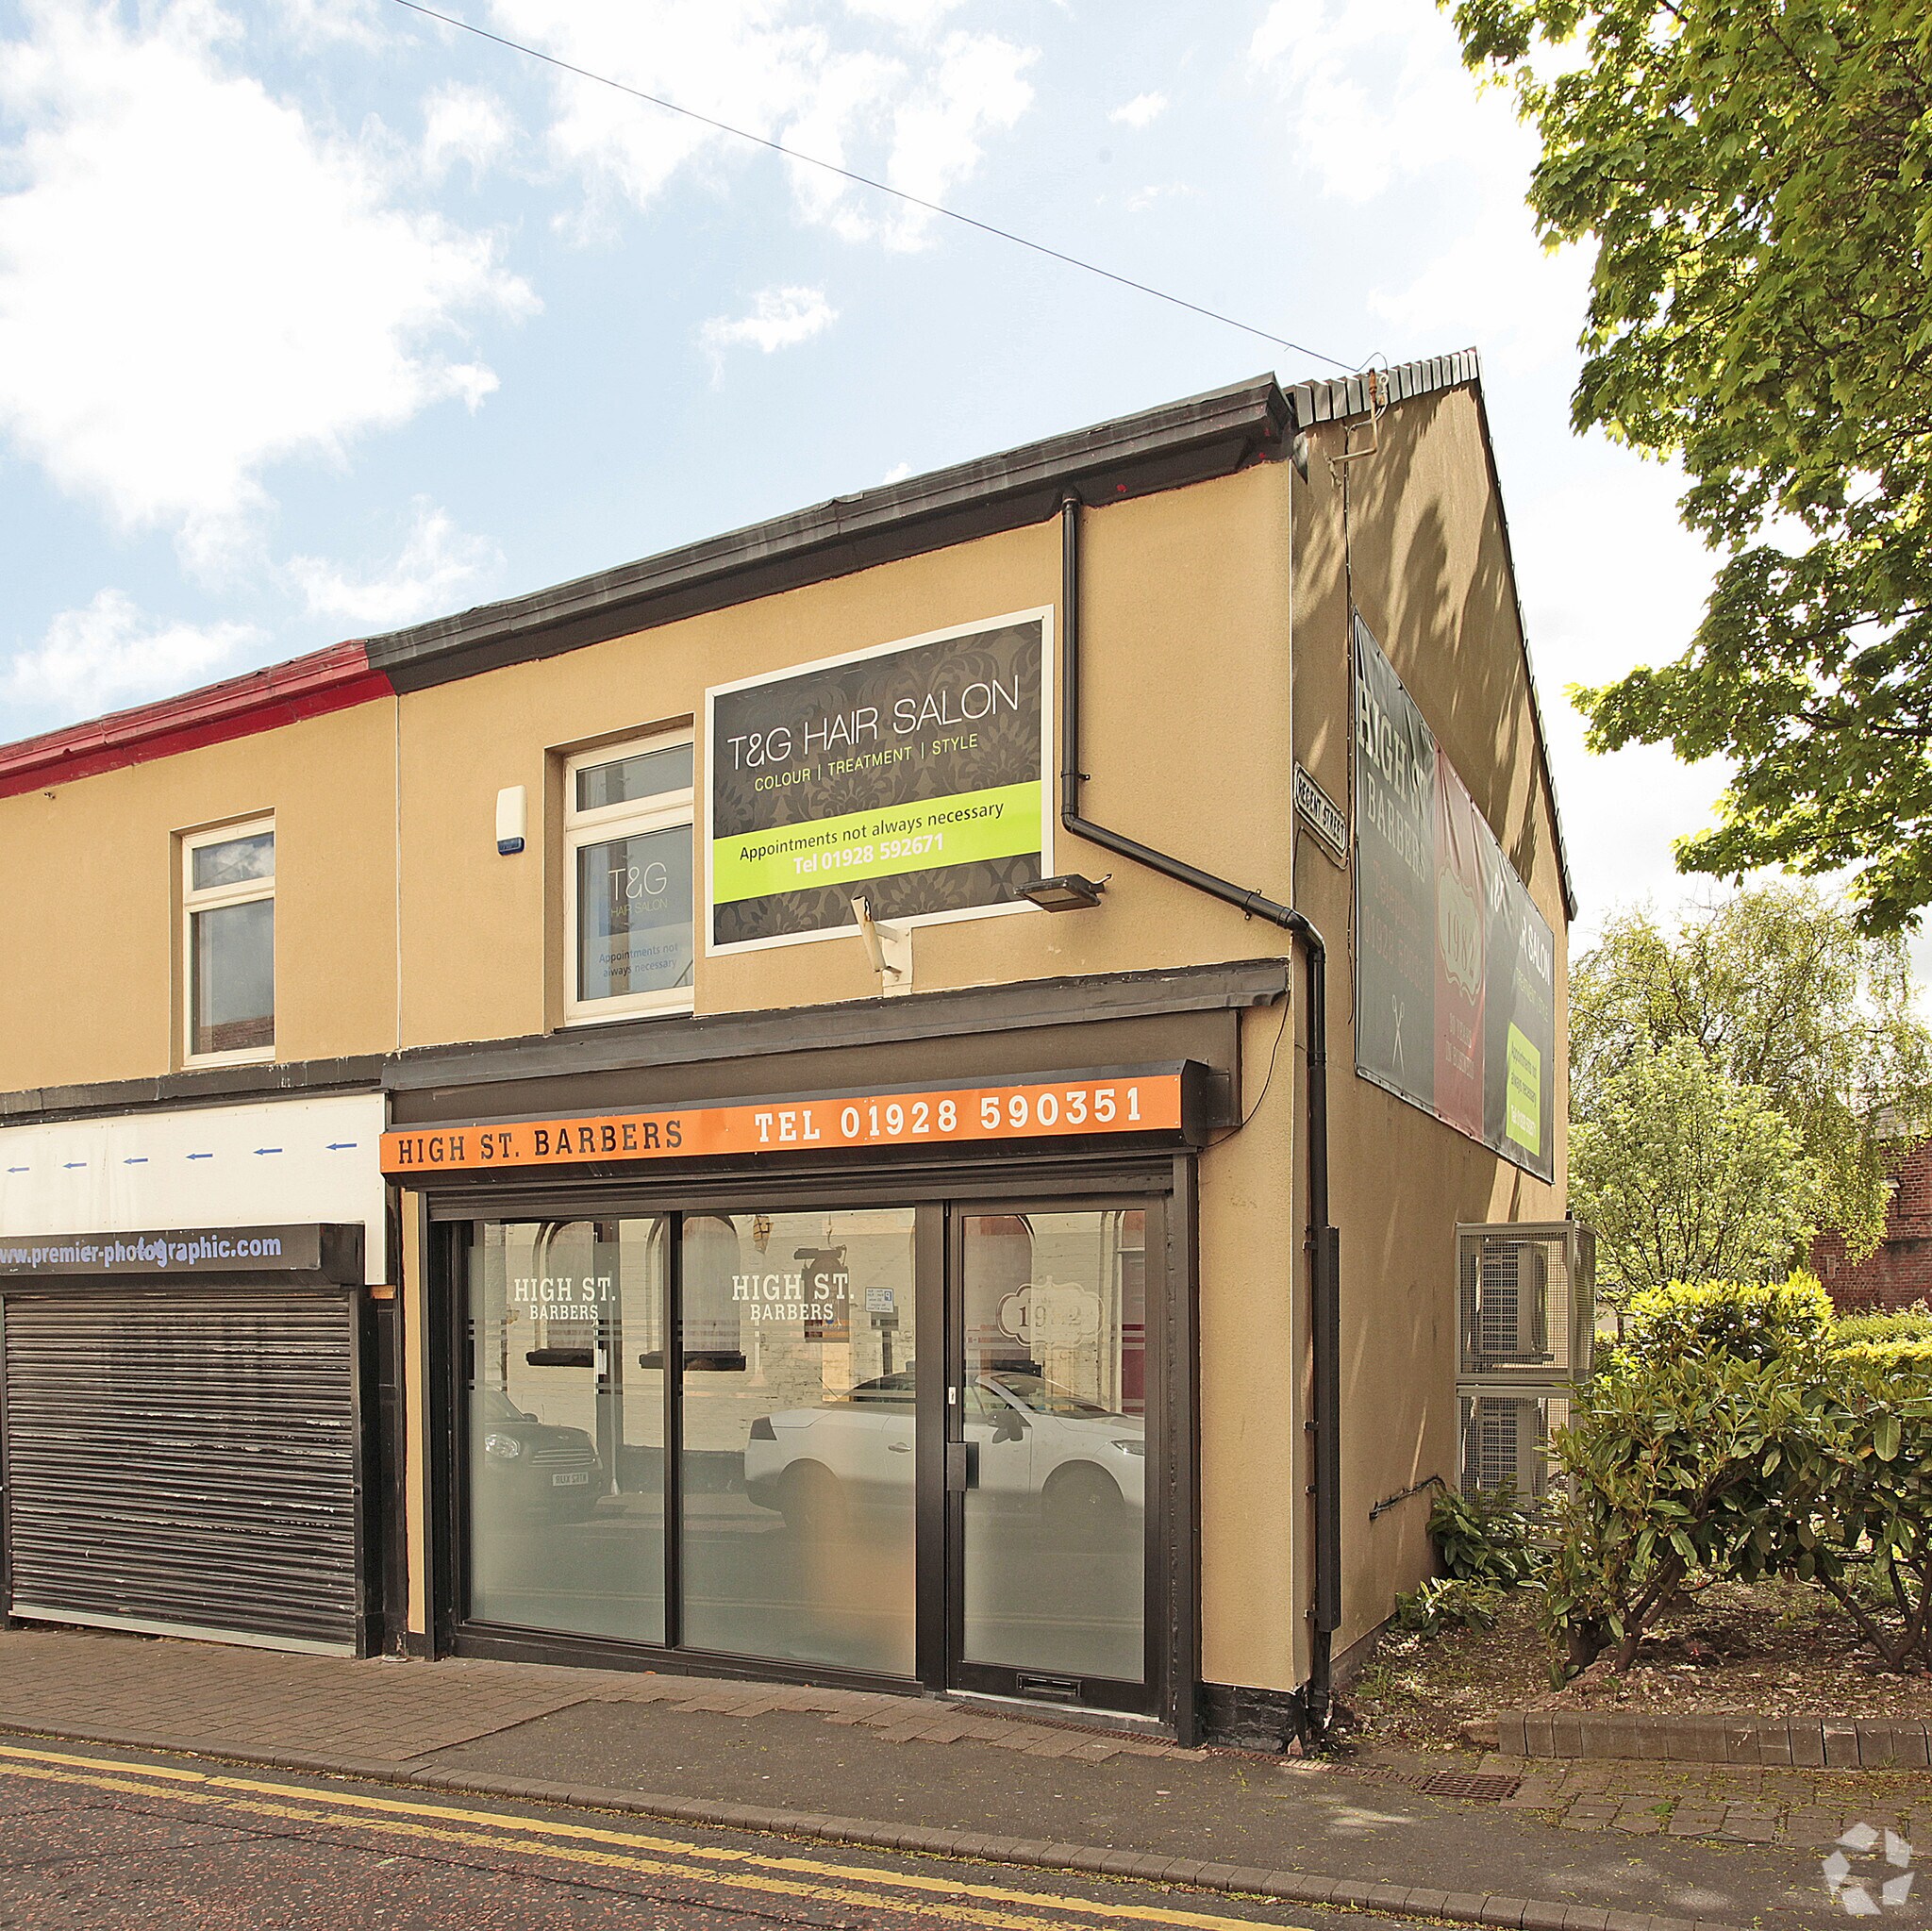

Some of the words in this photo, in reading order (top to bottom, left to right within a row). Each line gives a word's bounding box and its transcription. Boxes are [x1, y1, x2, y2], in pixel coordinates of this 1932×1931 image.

[727, 727, 791, 771] T&G
[804, 707, 878, 755] HAIR
[892, 674, 1019, 734] SALON
[1357, 676, 1407, 803] HIGH
[755, 768, 811, 792] COLOUR
[828, 746, 912, 776] TREATMENT
[932, 733, 978, 756] STYLE
[739, 831, 838, 862] Appointments
[842, 824, 867, 841] not
[872, 815, 923, 839] always
[927, 801, 1005, 827] necessary
[1298, 777, 1322, 819] REGENT
[1323, 804, 1345, 844] STREET
[1367, 772, 1425, 884] BARBERS
[793, 854, 818, 874] Tel
[821, 844, 874, 871] 01928
[878, 832, 943, 861] 592671
[608, 861, 667, 901] T&G
[610, 903, 631, 918] HAIR
[635, 897, 668, 914] SALON
[599, 944, 660, 965] Appointments
[662, 943, 678, 955] not
[1362, 905, 1394, 964] 01928
[1447, 909, 1474, 978] 1982
[1528, 923, 1551, 987] SALON
[603, 964, 631, 978] always
[634, 957, 676, 974] necessary
[755, 1109, 820, 1142] TEL
[841, 1099, 958, 1138] 01928
[980, 1087, 1141, 1129] 590351
[398, 1135, 465, 1164] HIGH
[480, 1132, 520, 1160] ST.
[534, 1119, 683, 1157] BARBERS
[514, 1277, 573, 1303] HIGH
[582, 1276, 616, 1302] ST.
[732, 1273, 802, 1301] HIGH
[814, 1273, 855, 1300] ST.
[529, 1304, 600, 1321] BARBERS
[750, 1303, 834, 1321] BARBERS
[1019, 1306, 1082, 1327] 192
